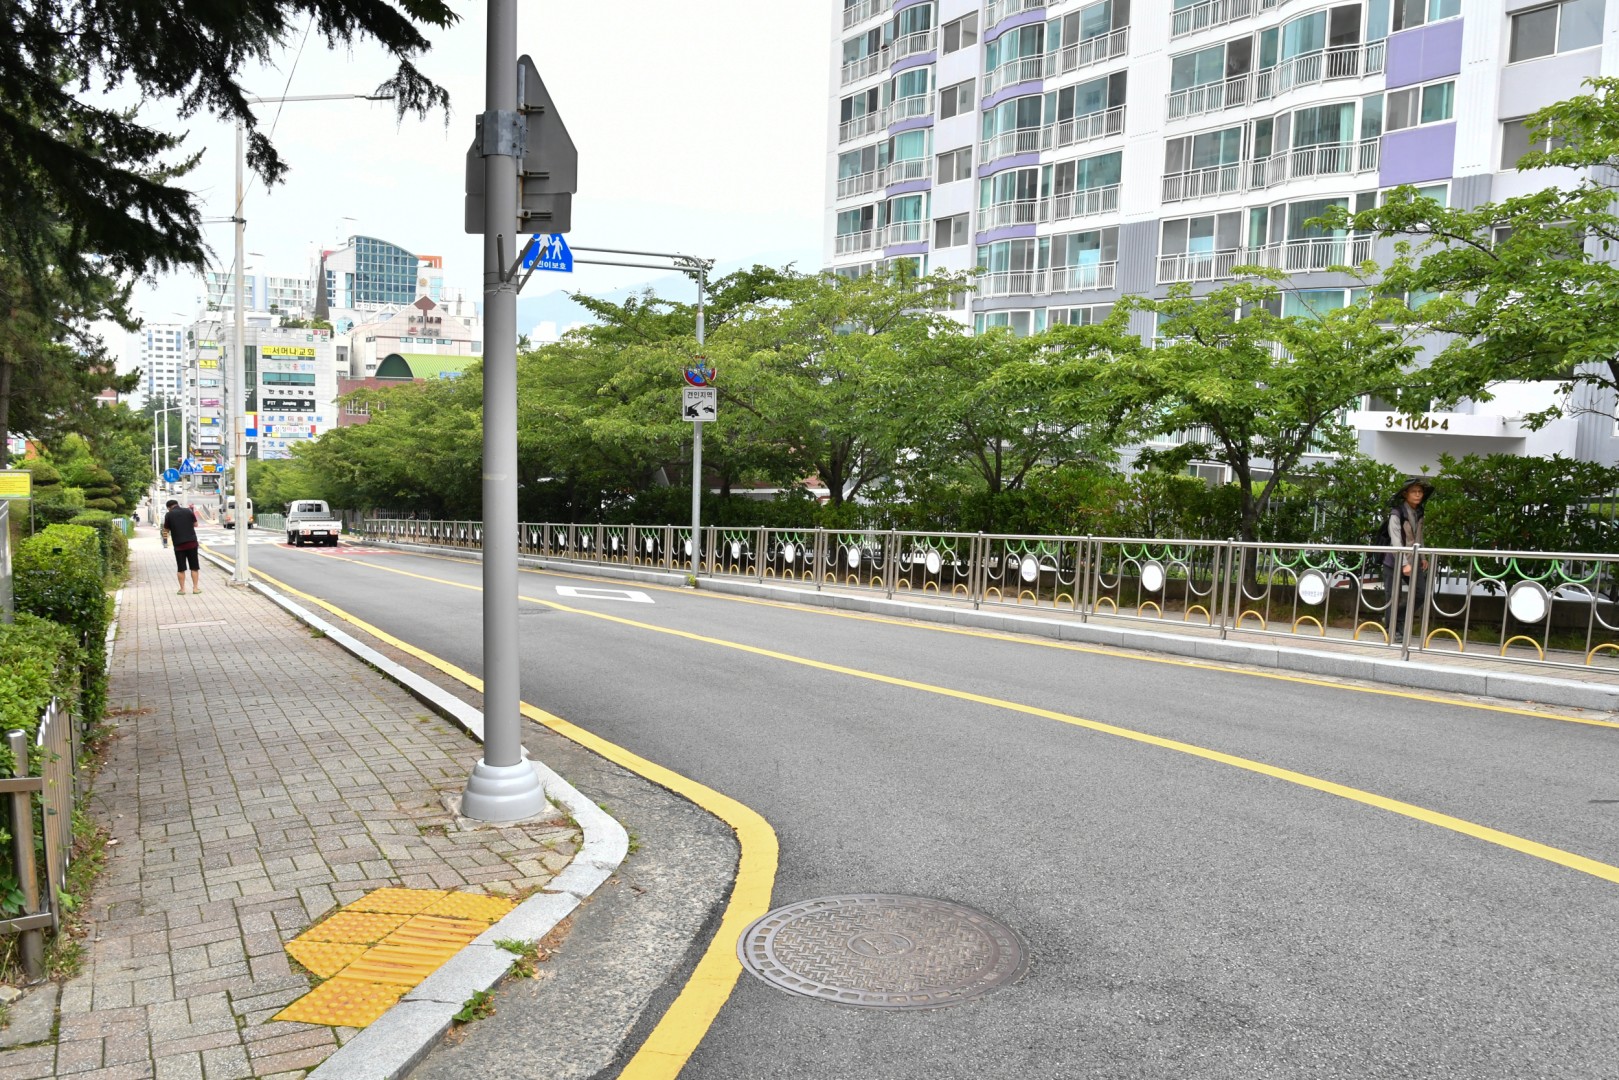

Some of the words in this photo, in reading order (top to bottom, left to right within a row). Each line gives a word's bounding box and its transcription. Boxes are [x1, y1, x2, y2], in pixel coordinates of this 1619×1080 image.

[272, 347, 315, 355] 서머나교회
[687, 391, 713, 399] 견인지역
[1385, 416, 1393, 428] 3
[1405, 416, 1429, 431] 104
[1440, 418, 1449, 431] 4
